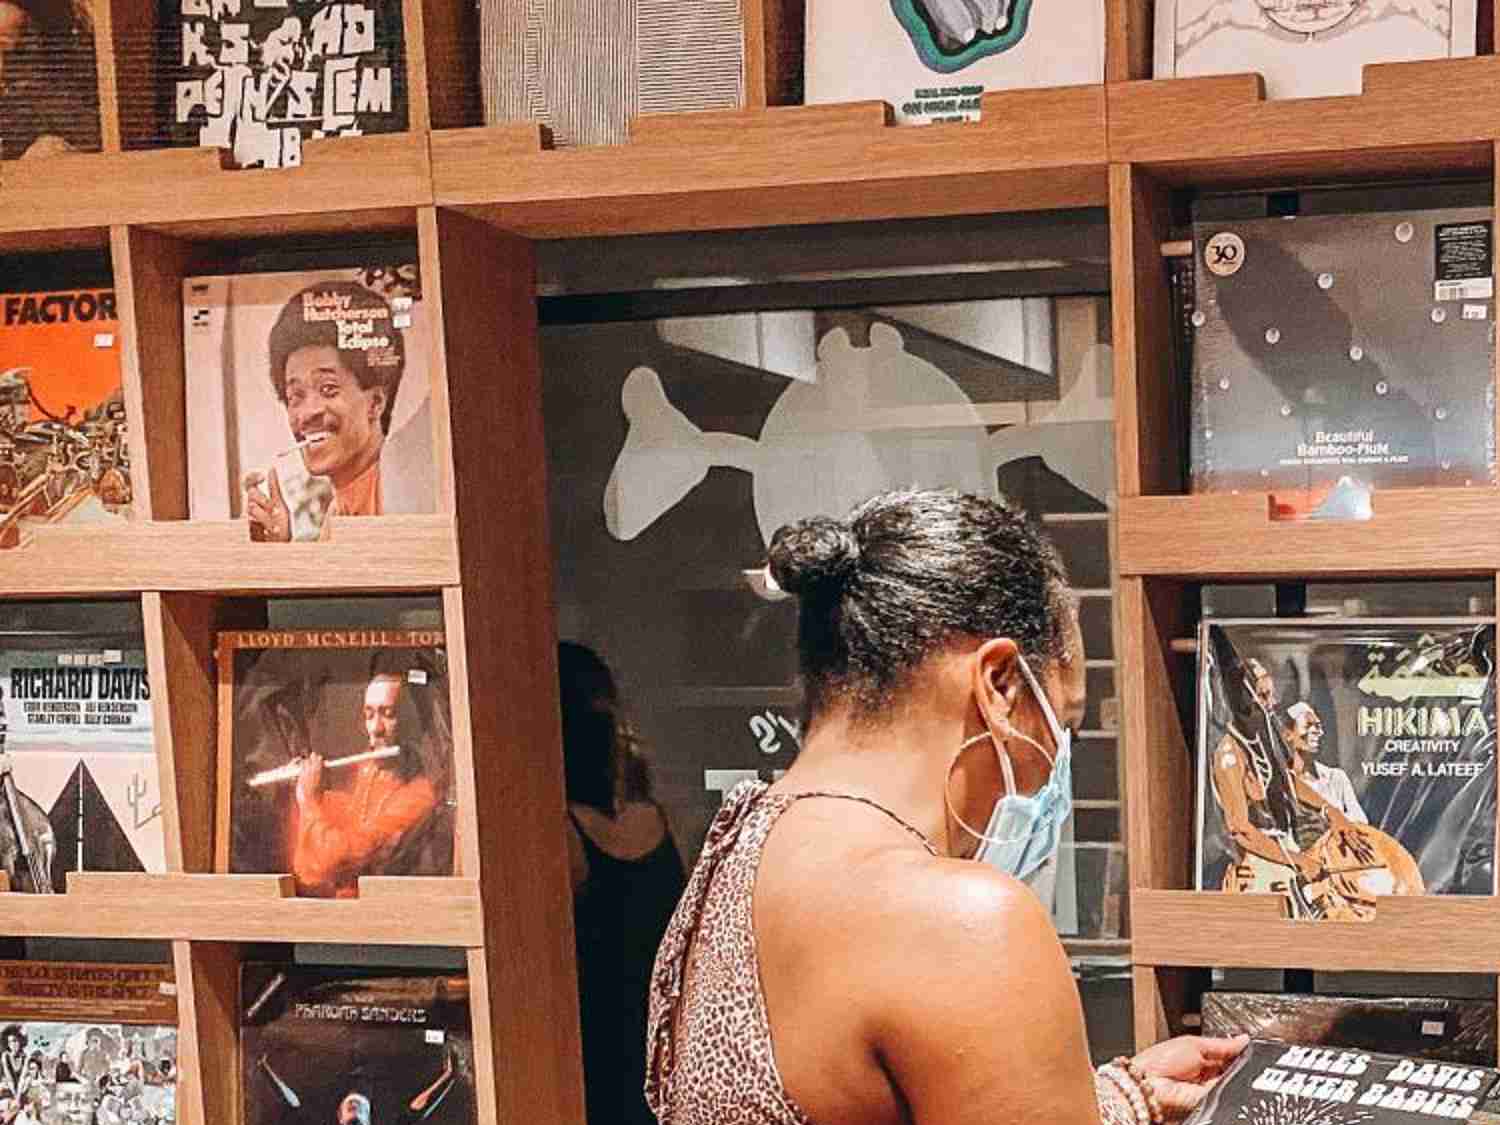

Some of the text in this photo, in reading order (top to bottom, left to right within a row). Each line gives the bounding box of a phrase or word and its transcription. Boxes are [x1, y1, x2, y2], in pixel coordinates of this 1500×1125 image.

[5, 292, 118, 325] FACTOR
[336, 319, 373, 335] Total
[337, 334, 390, 351] Eclipse
[1315, 429, 1375, 443] Beautiful
[237, 631, 295, 649] LLOYD
[301, 630, 388, 648] MCNEILL
[10, 667, 151, 700] RICHARD DAVIS
[1358, 705, 1489, 737] HIKIMA
[1384, 738, 1461, 753] CREATIVITY
[1361, 760, 1485, 777] YUSEF A. LATEEF
[360, 1006, 427, 1024] SANDERS
[1274, 1045, 1485, 1092] MILES DAVIS
[1252, 1067, 1479, 1120] WATER BABIES
